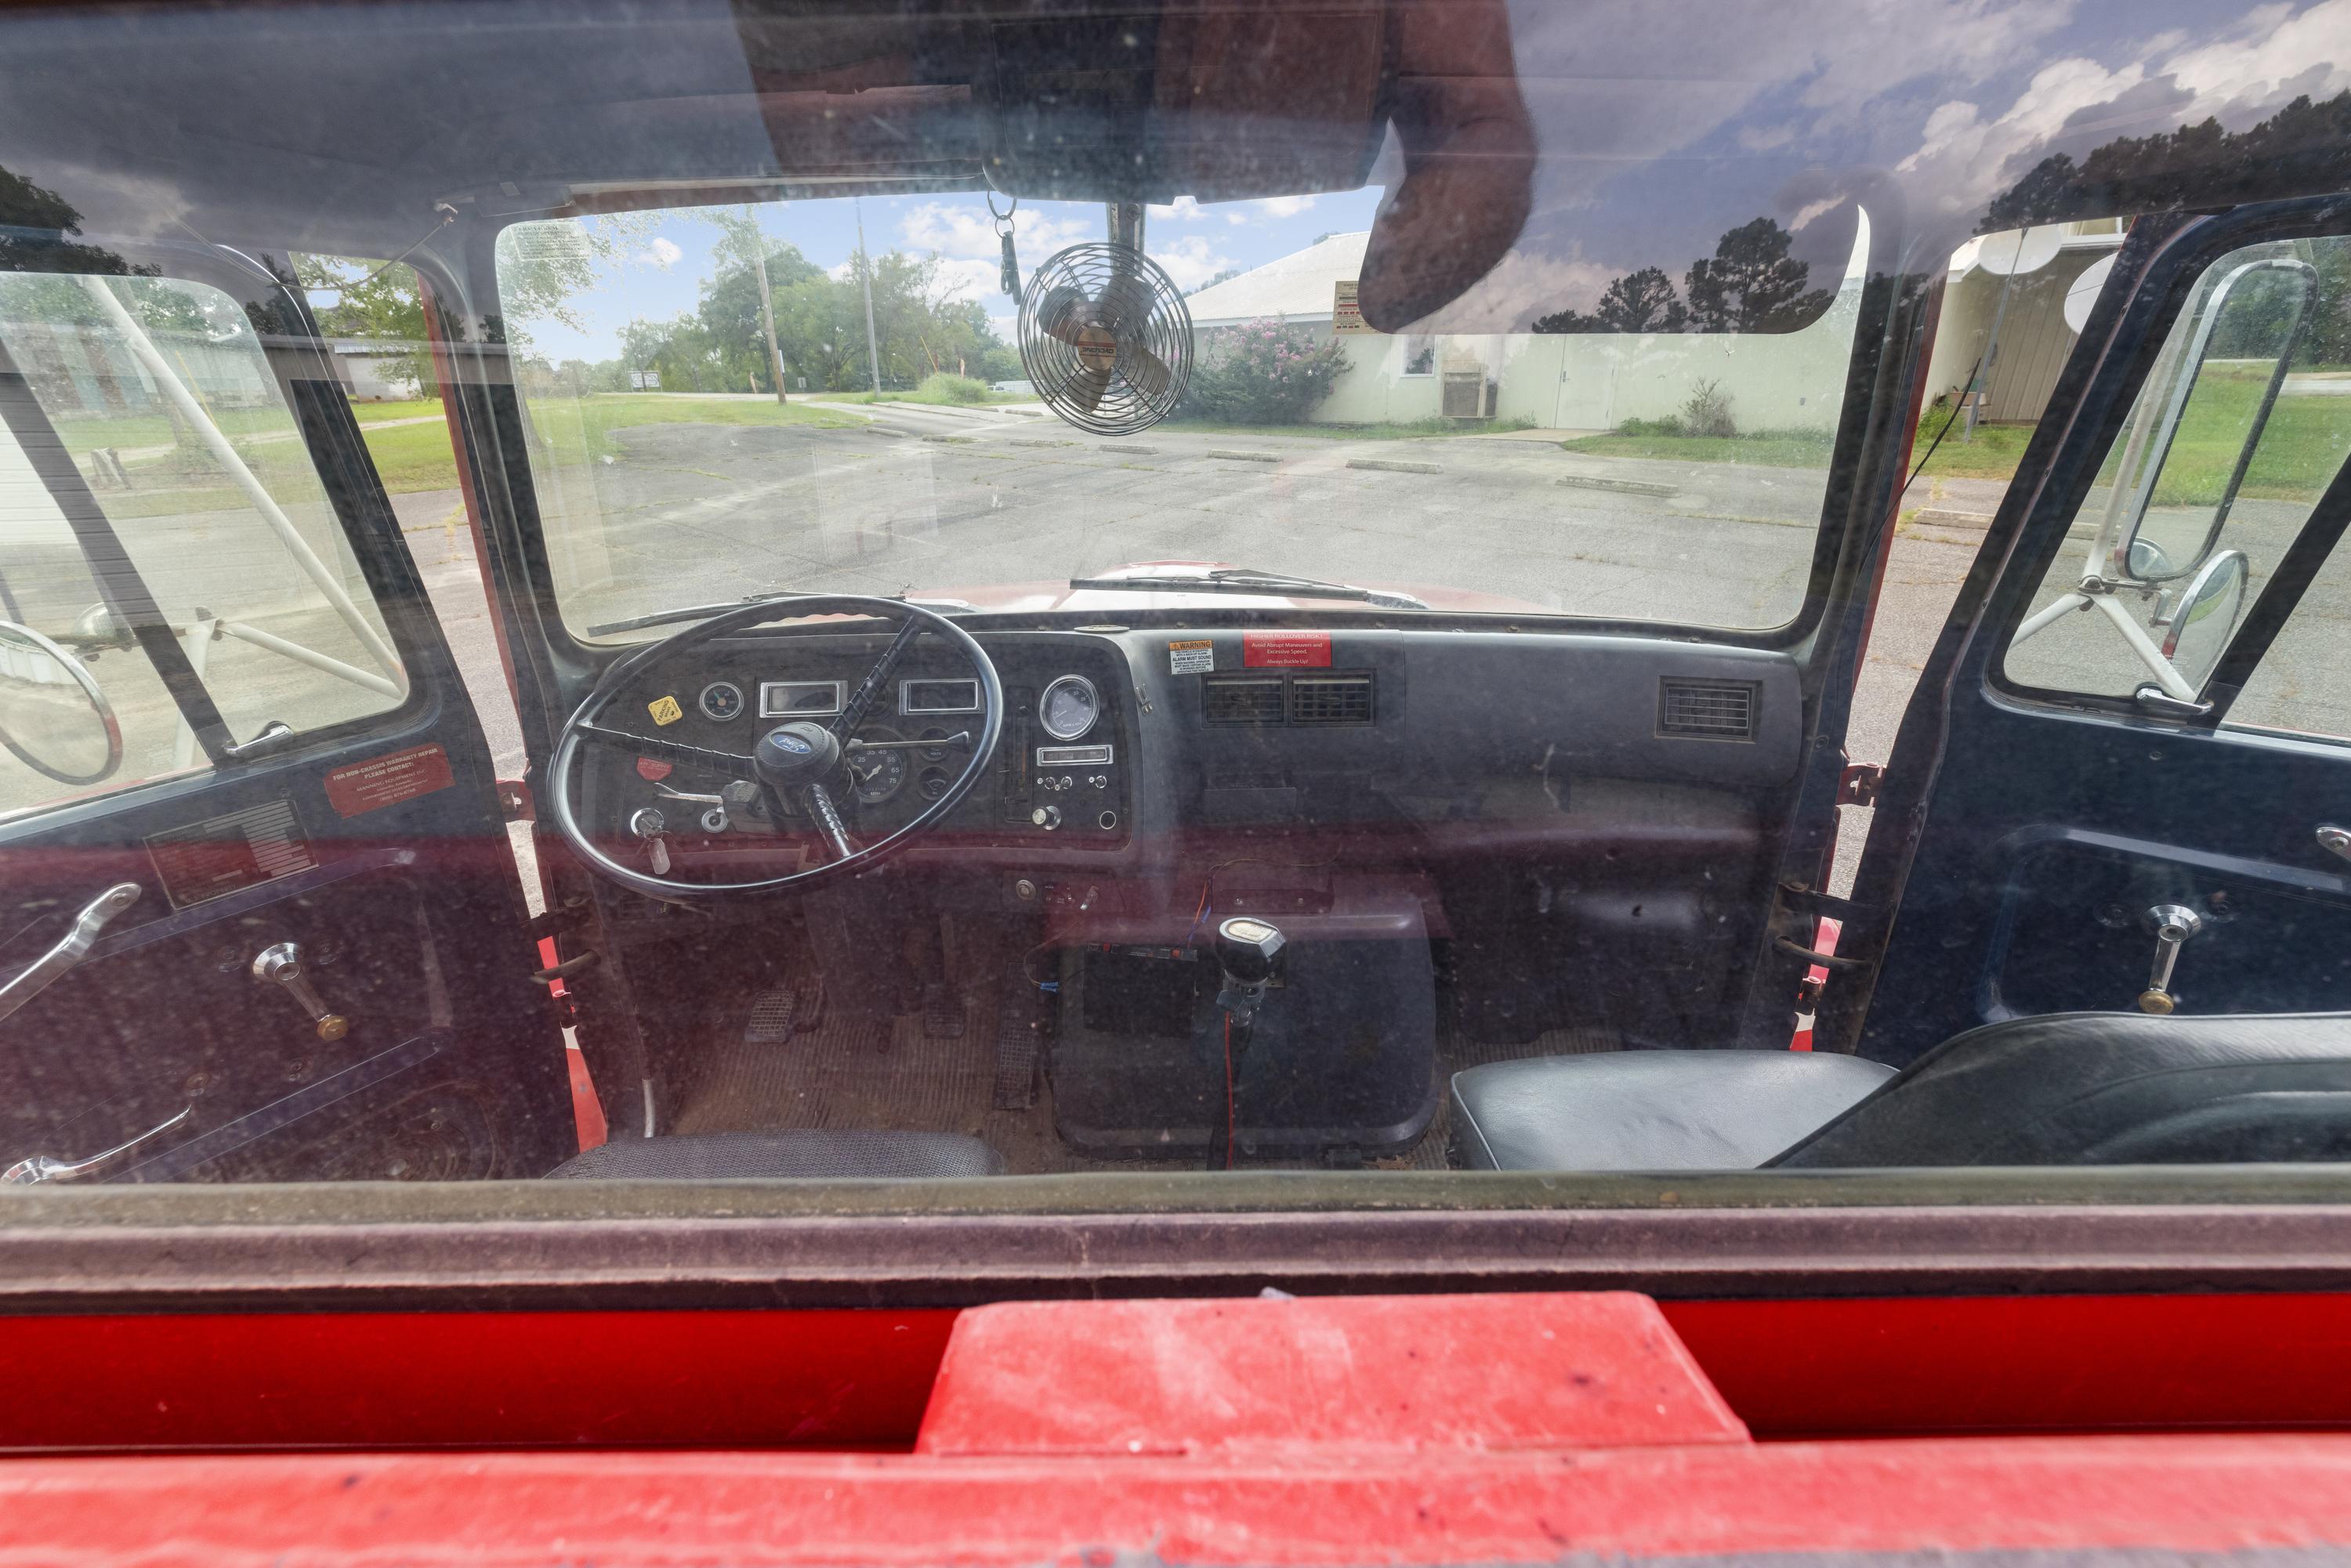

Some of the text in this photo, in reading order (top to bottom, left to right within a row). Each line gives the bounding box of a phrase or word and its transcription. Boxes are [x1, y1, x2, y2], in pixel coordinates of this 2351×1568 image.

[657, 700, 669, 721] PARKING
[778, 737, 805, 751] Ford
[346, 762, 386, 777] NON-CHASSIS
[386, 755, 417, 767] WARRANTY
[418, 748, 437, 758] REPAIR
[357, 780, 384, 791] MANNING
[385, 773, 415, 784] EQUIPMENT
[364, 770, 386, 779] PLEASE
